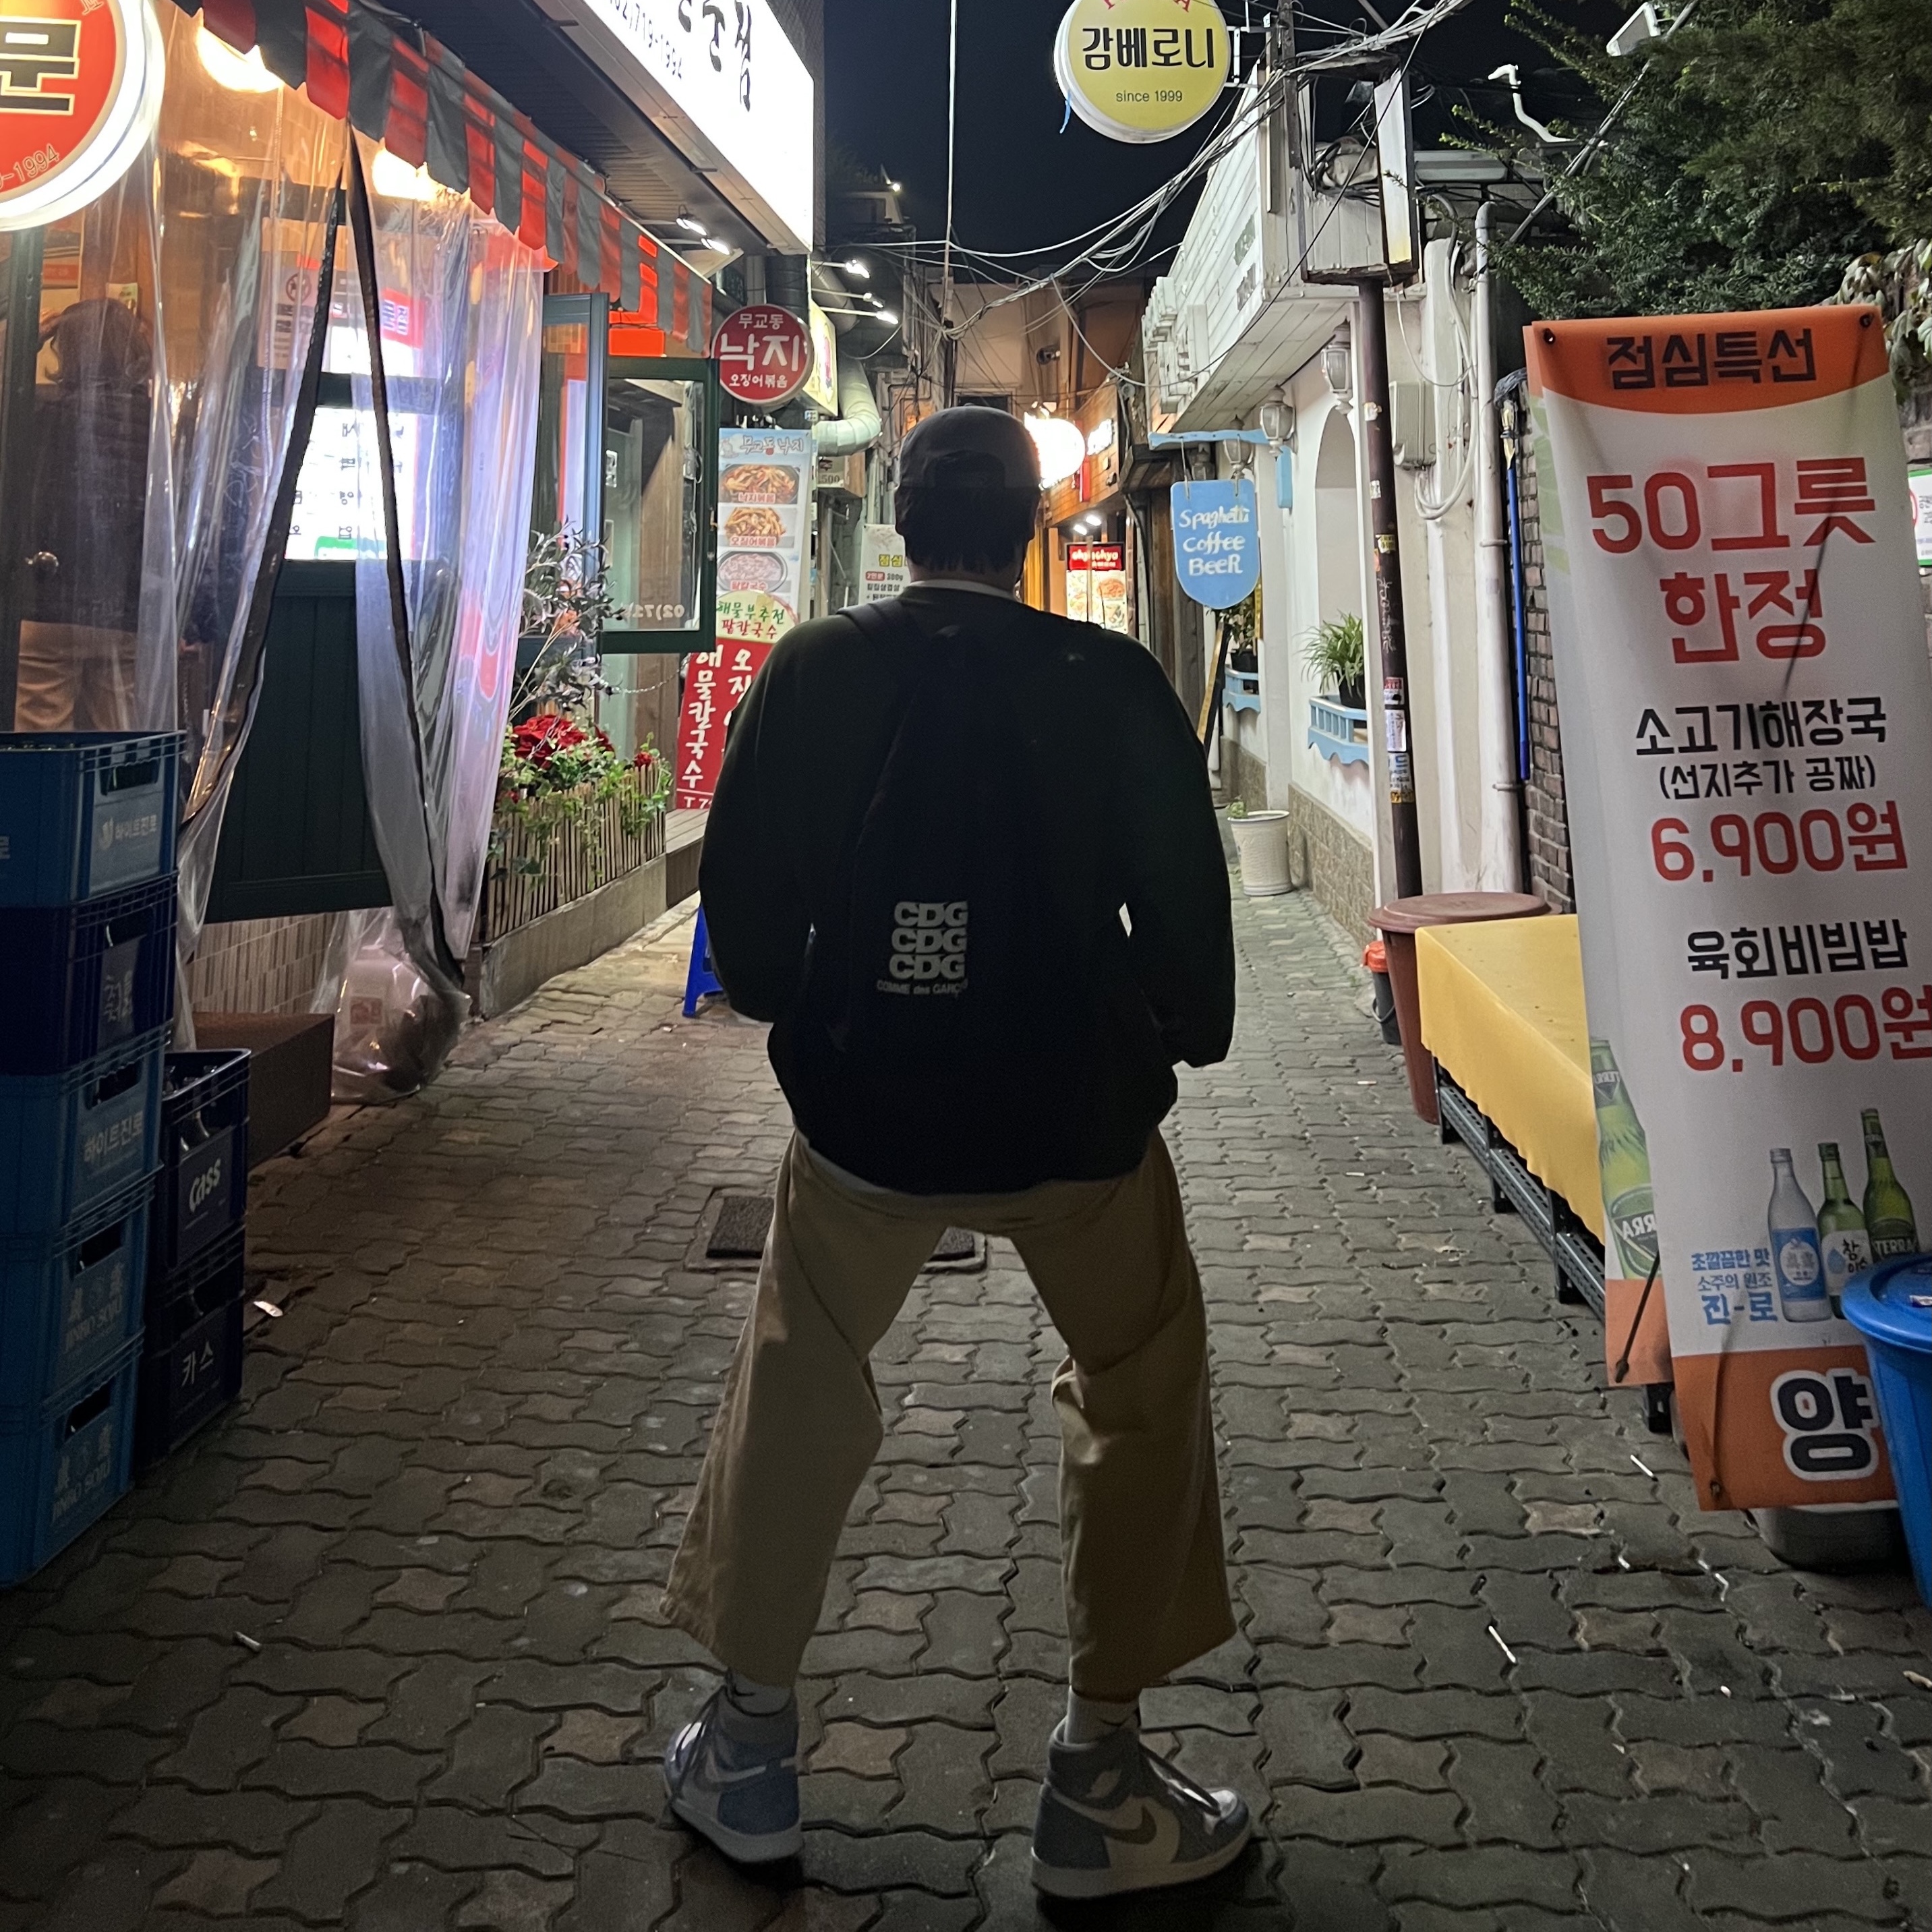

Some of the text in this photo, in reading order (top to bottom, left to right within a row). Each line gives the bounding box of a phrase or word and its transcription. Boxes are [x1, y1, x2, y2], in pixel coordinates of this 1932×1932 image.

[1082, 28, 1214, 70] 감베로니
[1116, 90, 1183, 102] since 1999
[0, 143, 59, 192] -1994
[738, 313, 784, 330] 무교동
[720, 333, 800, 371] 낙지
[1606, 327, 1817, 390] 점심특선
[729, 374, 788, 388] 오징어볶음
[740, 435, 804, 455] 무교동 낙지
[1179, 505, 1250, 529] Spaghetti
[1586, 457, 1877, 554] 50그릇
[1183, 531, 1246, 554] Coffee
[879, 554, 907, 567] 점심
[1660, 568, 1826, 664] 한정
[1635, 697, 1887, 755] 소고기해장국
[1659, 755, 1877, 800] (선지추가 공짜)
[684, 796, 712, 809] T 7
[1651, 800, 1908, 883] 6.900원
[894, 901, 968, 927] CDG
[891, 927, 967, 954] CDG
[1687, 919, 1909, 980] 육회비빔밥
[889, 954, 966, 980] CDG
[1680, 985, 1932, 1072] 8.900원
[1691, 1250, 1751, 1271] 초깔끔한
[1754, 1248, 1770, 1267] 맛
[1842, 1237, 1860, 1260] 참
[1698, 1272, 1773, 1291] 소주의 원조
[181, 1341, 215, 1388] 카스
[1774, 1372, 1878, 1476] 양
